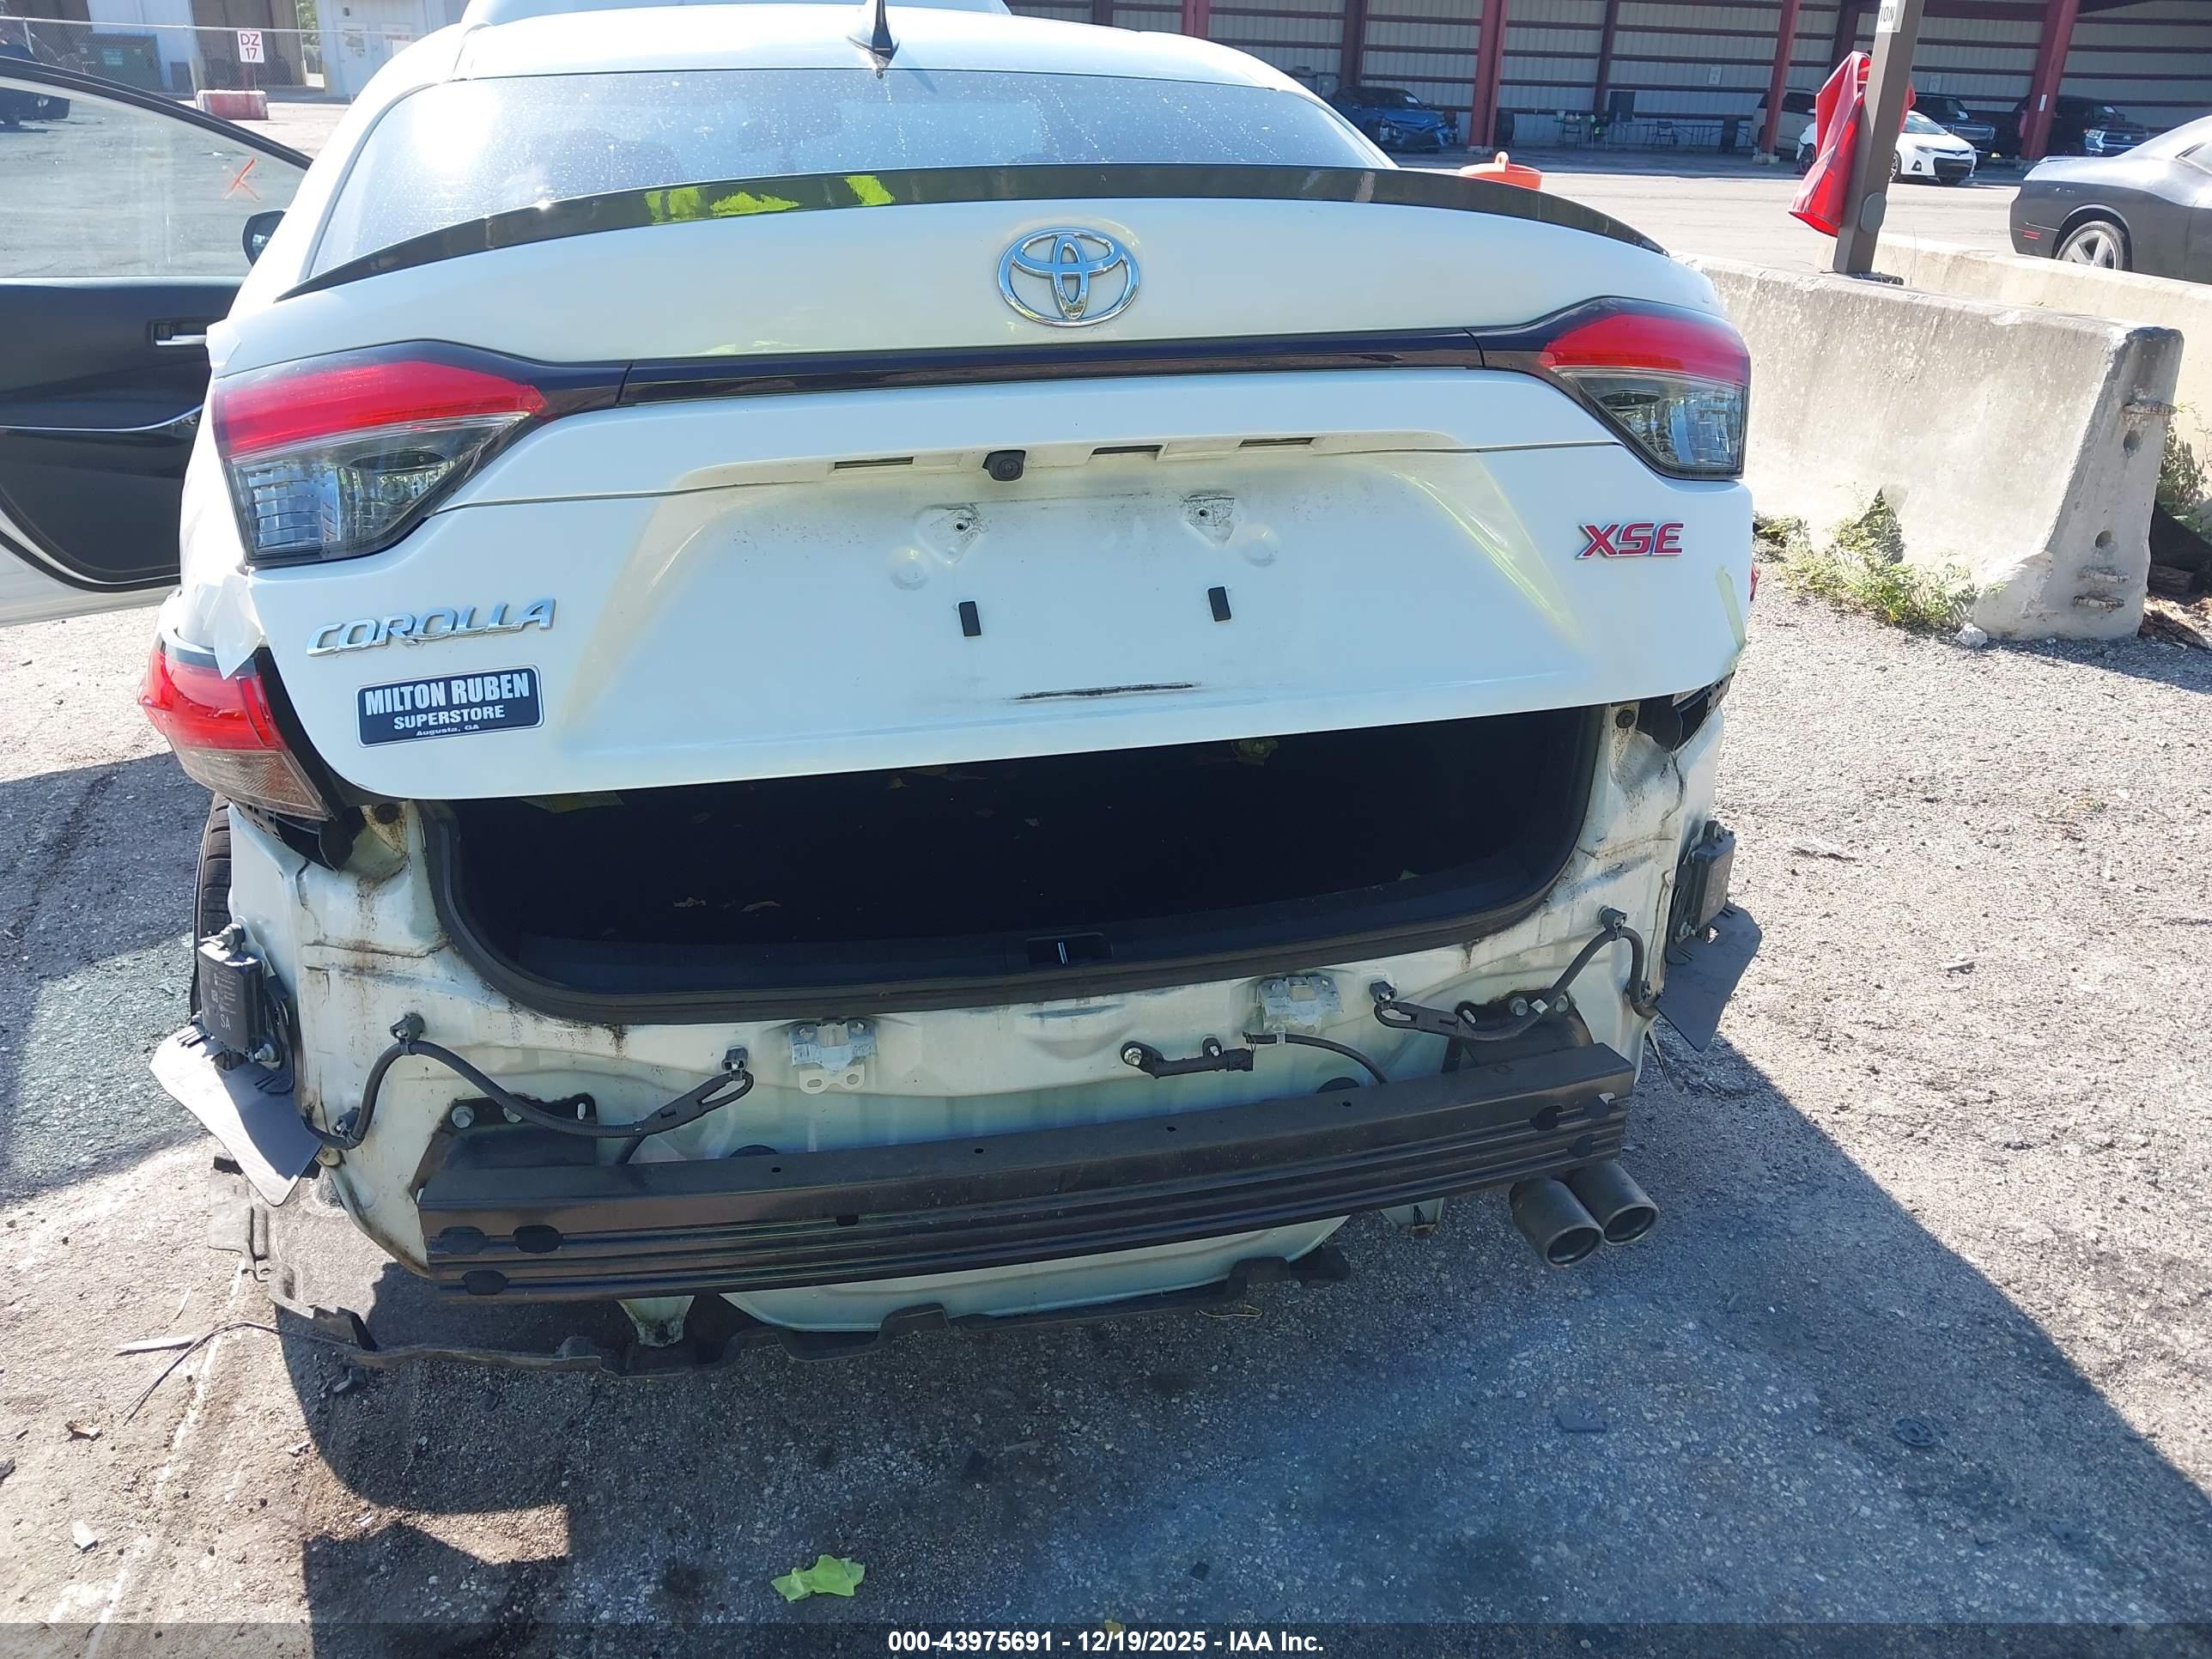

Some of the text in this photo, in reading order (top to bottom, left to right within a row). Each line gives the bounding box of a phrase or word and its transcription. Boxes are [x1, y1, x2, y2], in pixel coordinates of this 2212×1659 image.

[240, 33, 260, 46] DZ
[245, 47, 258, 60] 17
[1575, 521, 1685, 559] XSE
[306, 597, 556, 656] COROLLA
[364, 672, 531, 715] MILTON RUBEN
[393, 704, 506, 730] SUPERSTORE
[416, 726, 461, 737] Augusta,
